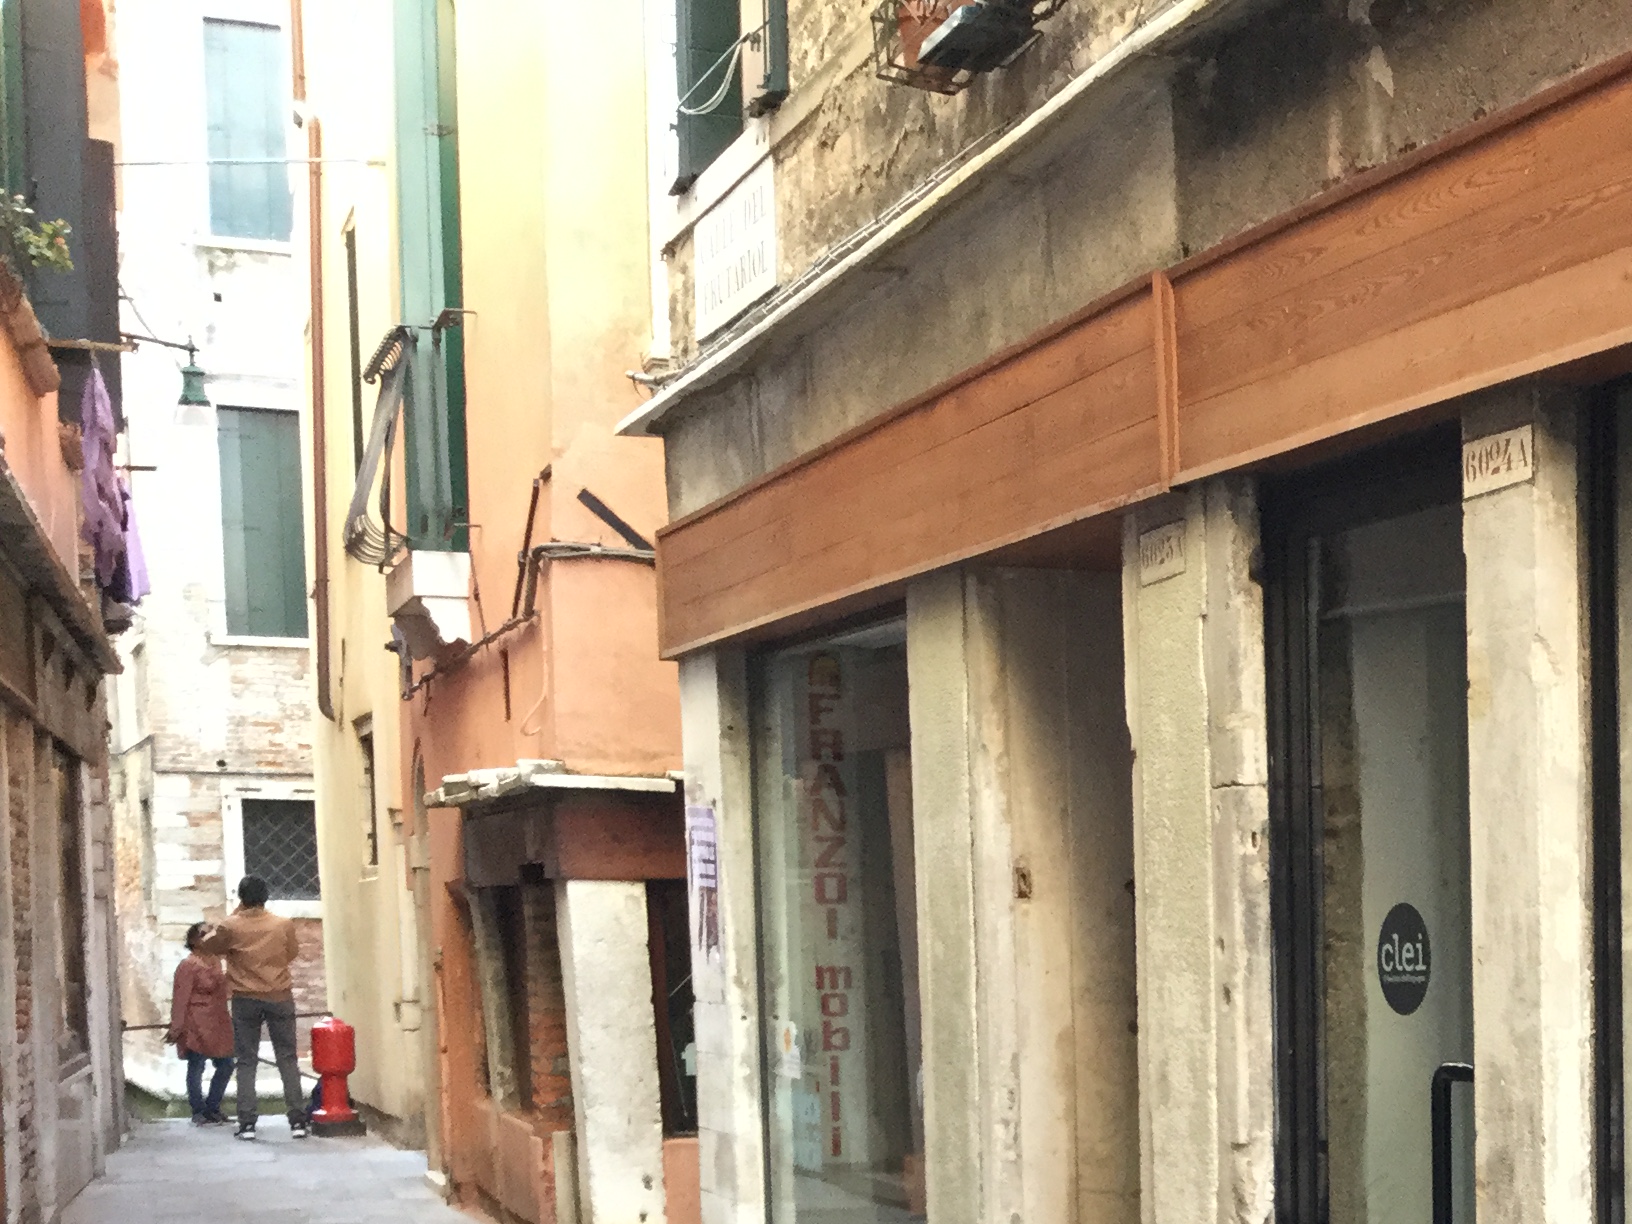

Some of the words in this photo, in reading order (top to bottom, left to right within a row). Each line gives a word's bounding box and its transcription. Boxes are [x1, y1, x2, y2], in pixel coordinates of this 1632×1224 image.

[700, 209, 735, 264] CALLE
[744, 185, 767, 231] DEL
[807, 691, 848, 940] FRANZOI
[1381, 933, 1427, 972] clei
[814, 965, 852, 1157] mobili
